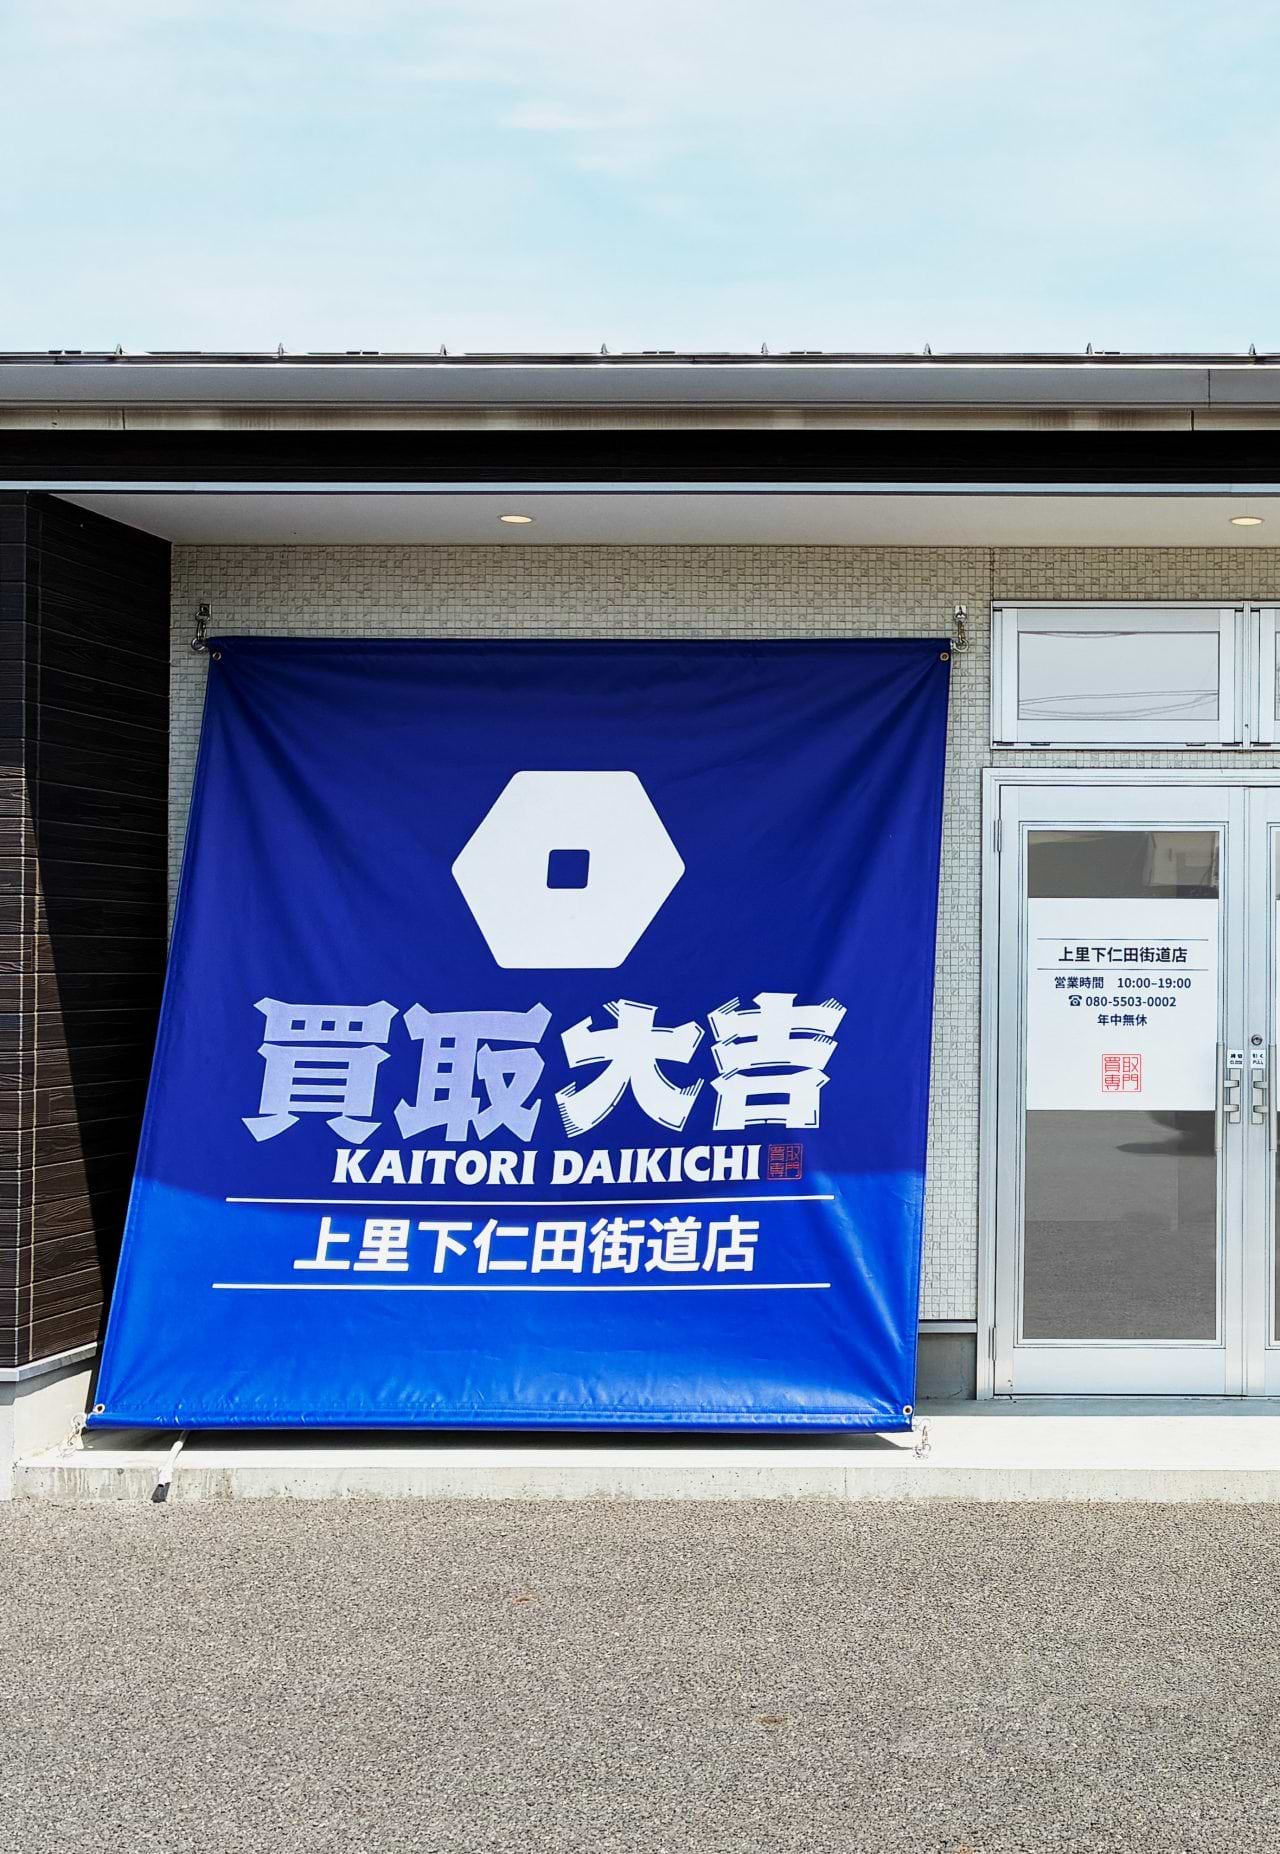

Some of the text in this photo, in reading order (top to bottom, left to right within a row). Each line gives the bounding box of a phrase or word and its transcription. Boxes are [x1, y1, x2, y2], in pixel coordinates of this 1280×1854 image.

[1058, 946, 1188, 963] 上里下仁田街道店
[1054, 976, 1104, 989] 営業時間
[1085, 996, 1177, 1007] 080-5503-0002
[1097, 1013, 1148, 1027] 年中無休
[242, 991, 848, 1143] 買取大吉
[332, 1144, 761, 1186] KAITORI DAIKICHI
[294, 1215, 760, 1274] 上里下仁田街道店
